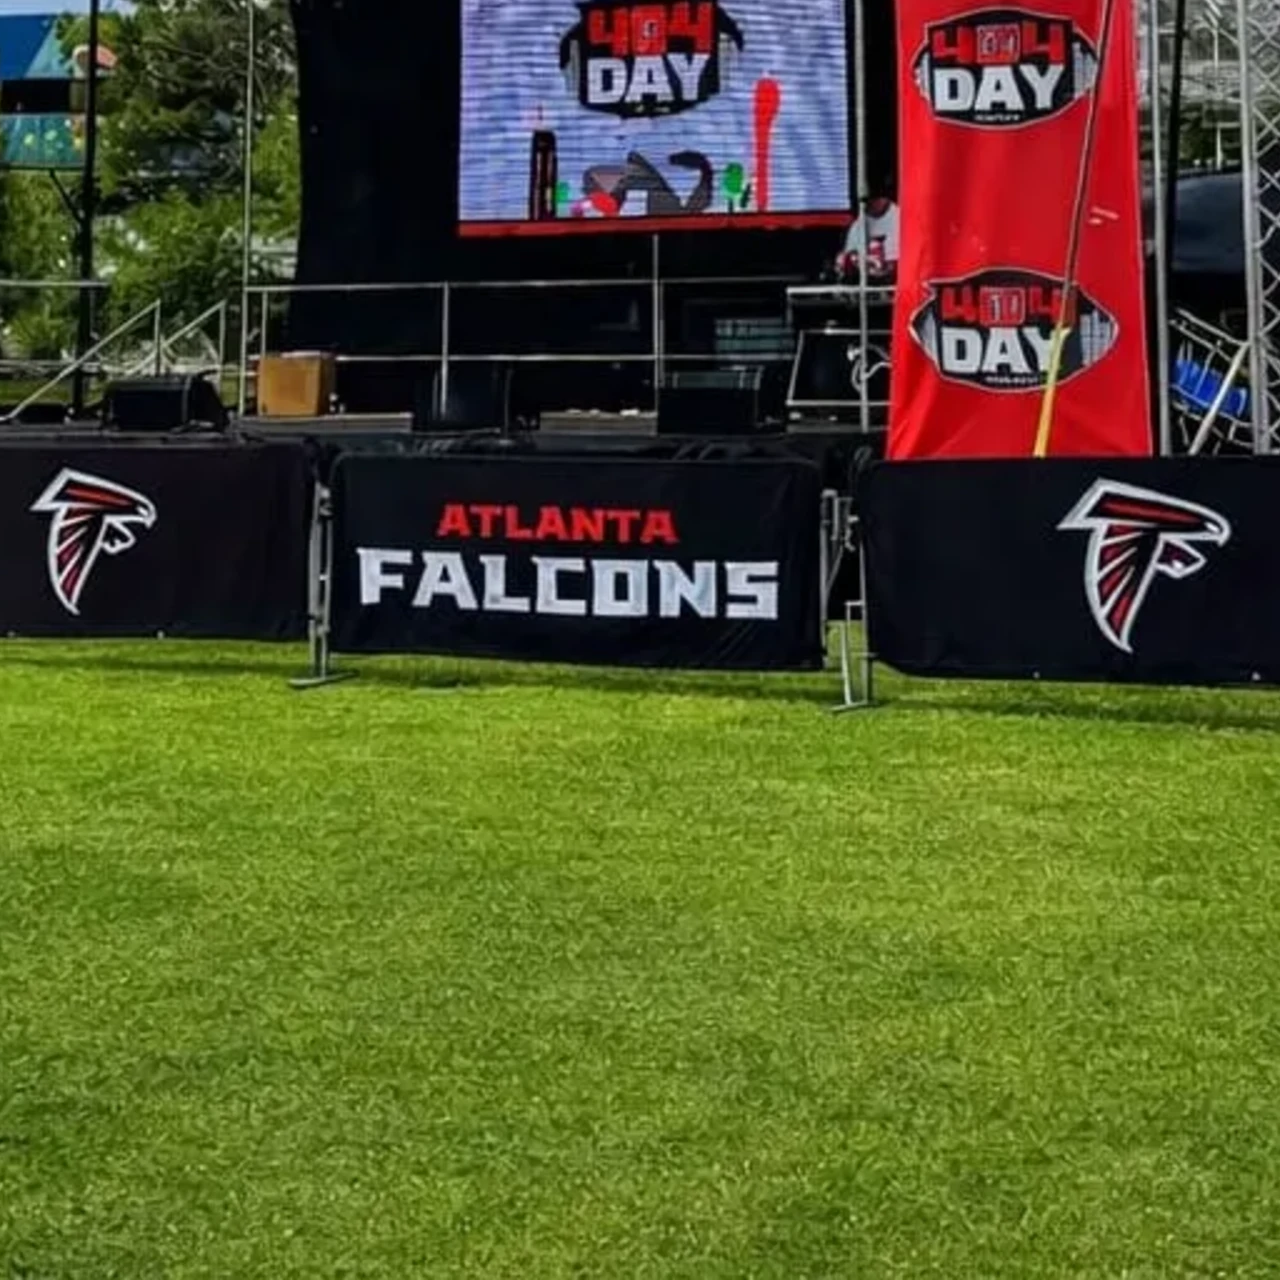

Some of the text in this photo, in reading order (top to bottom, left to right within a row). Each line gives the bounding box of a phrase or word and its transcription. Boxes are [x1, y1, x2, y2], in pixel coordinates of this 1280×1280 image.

[588, 1, 713, 59] 404
[587, 52, 710, 104] DAY
[934, 63, 1064, 112] DAY
[941, 326, 1072, 374] DAY
[437, 503, 679, 544] ATLANTA
[357, 547, 779, 619] FALCONS
